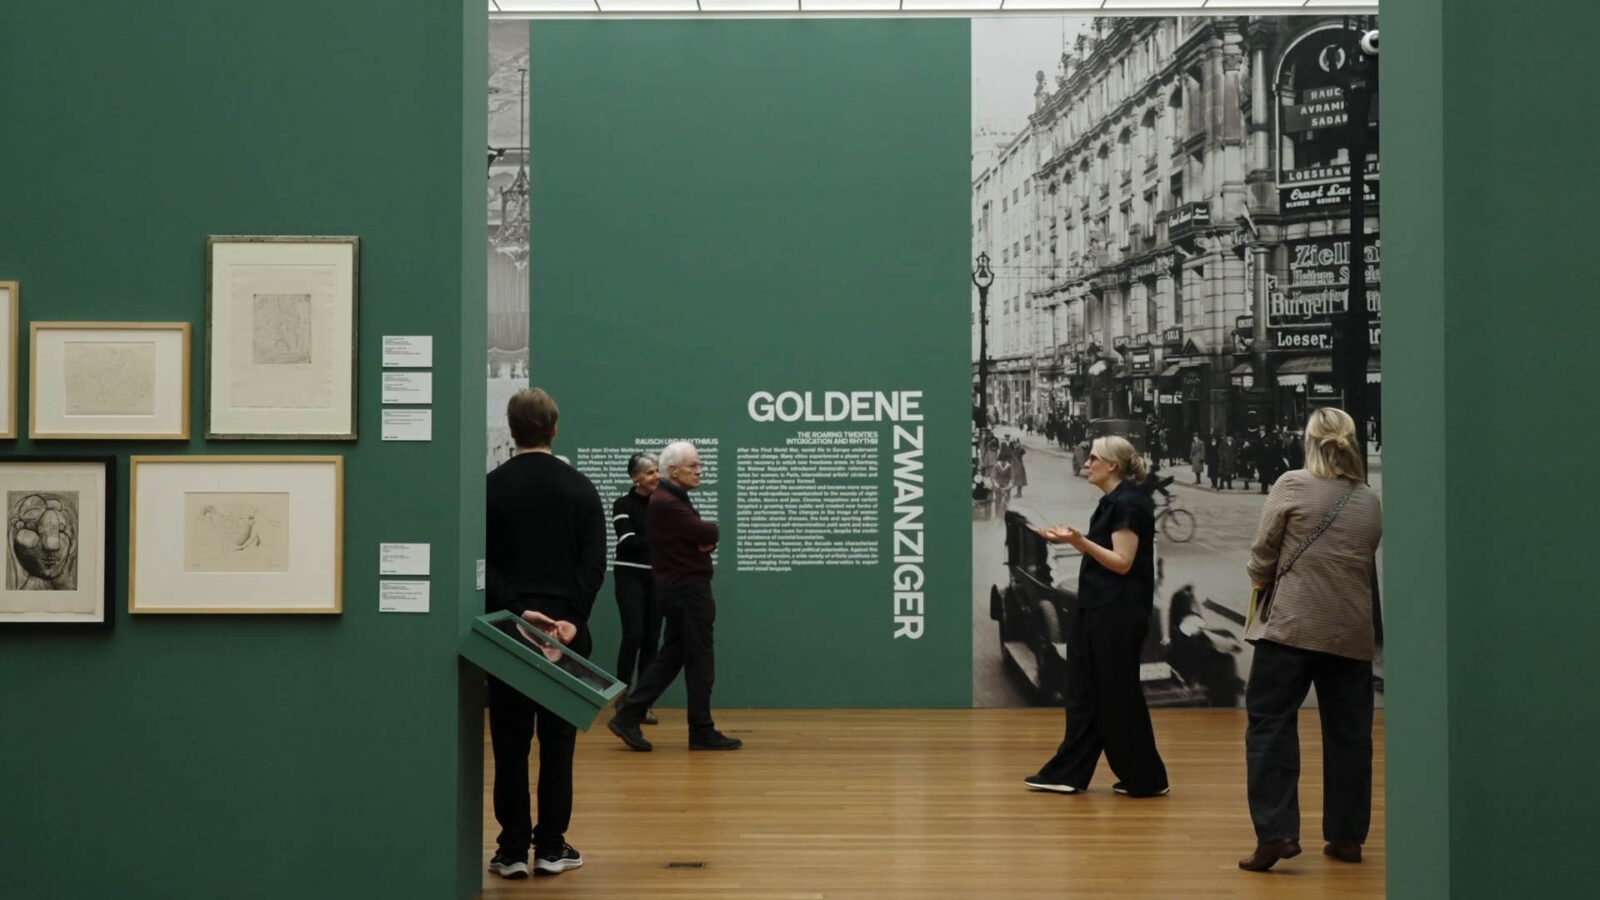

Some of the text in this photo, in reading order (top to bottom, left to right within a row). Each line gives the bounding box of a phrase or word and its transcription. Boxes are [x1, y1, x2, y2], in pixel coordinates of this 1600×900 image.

[1311, 87, 1343, 100] RAUC
[1289, 168, 1333, 181] LOESER
[1277, 332, 1327, 347] Loeser
[748, 391, 923, 422] GOLDENE
[893, 425, 924, 640] ZWANZIGER
